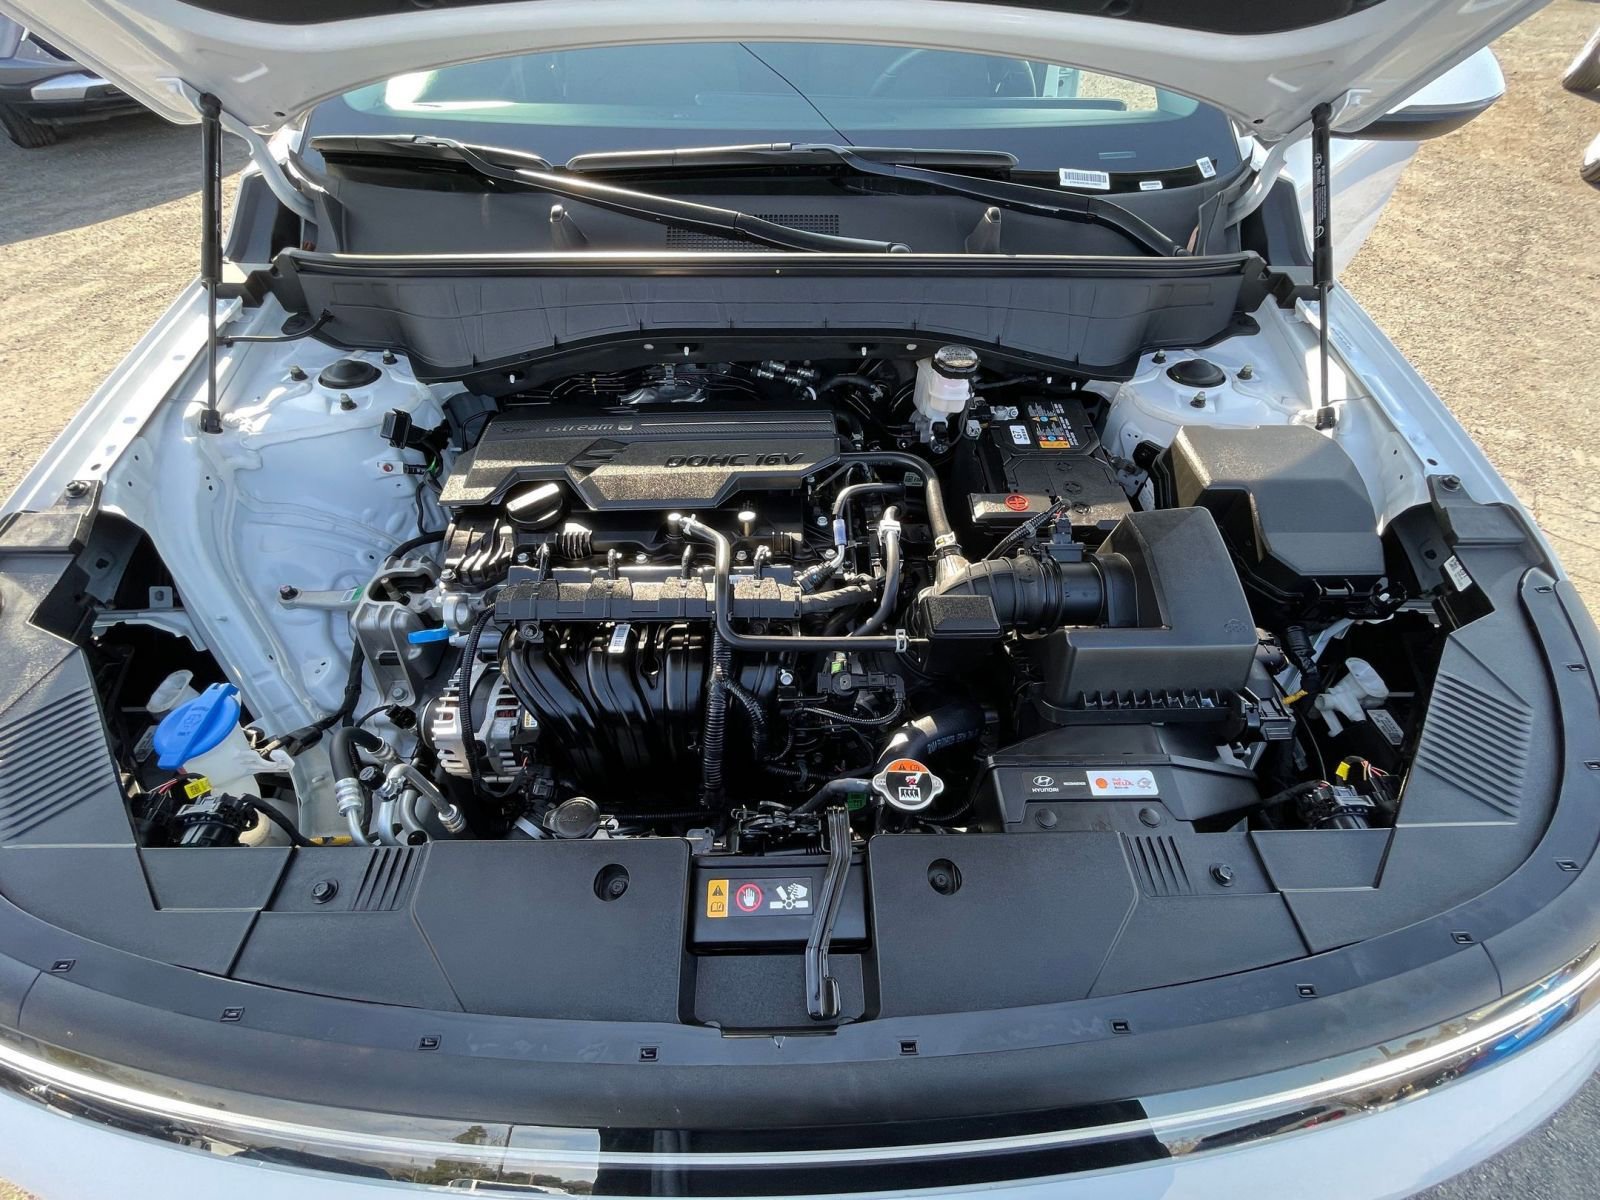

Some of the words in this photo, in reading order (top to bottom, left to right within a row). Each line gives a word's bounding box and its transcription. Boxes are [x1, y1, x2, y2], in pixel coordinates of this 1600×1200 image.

[502, 422, 615, 434] Smtstream
[664, 453, 750, 468] DOHC
[755, 452, 805, 466] 16V
